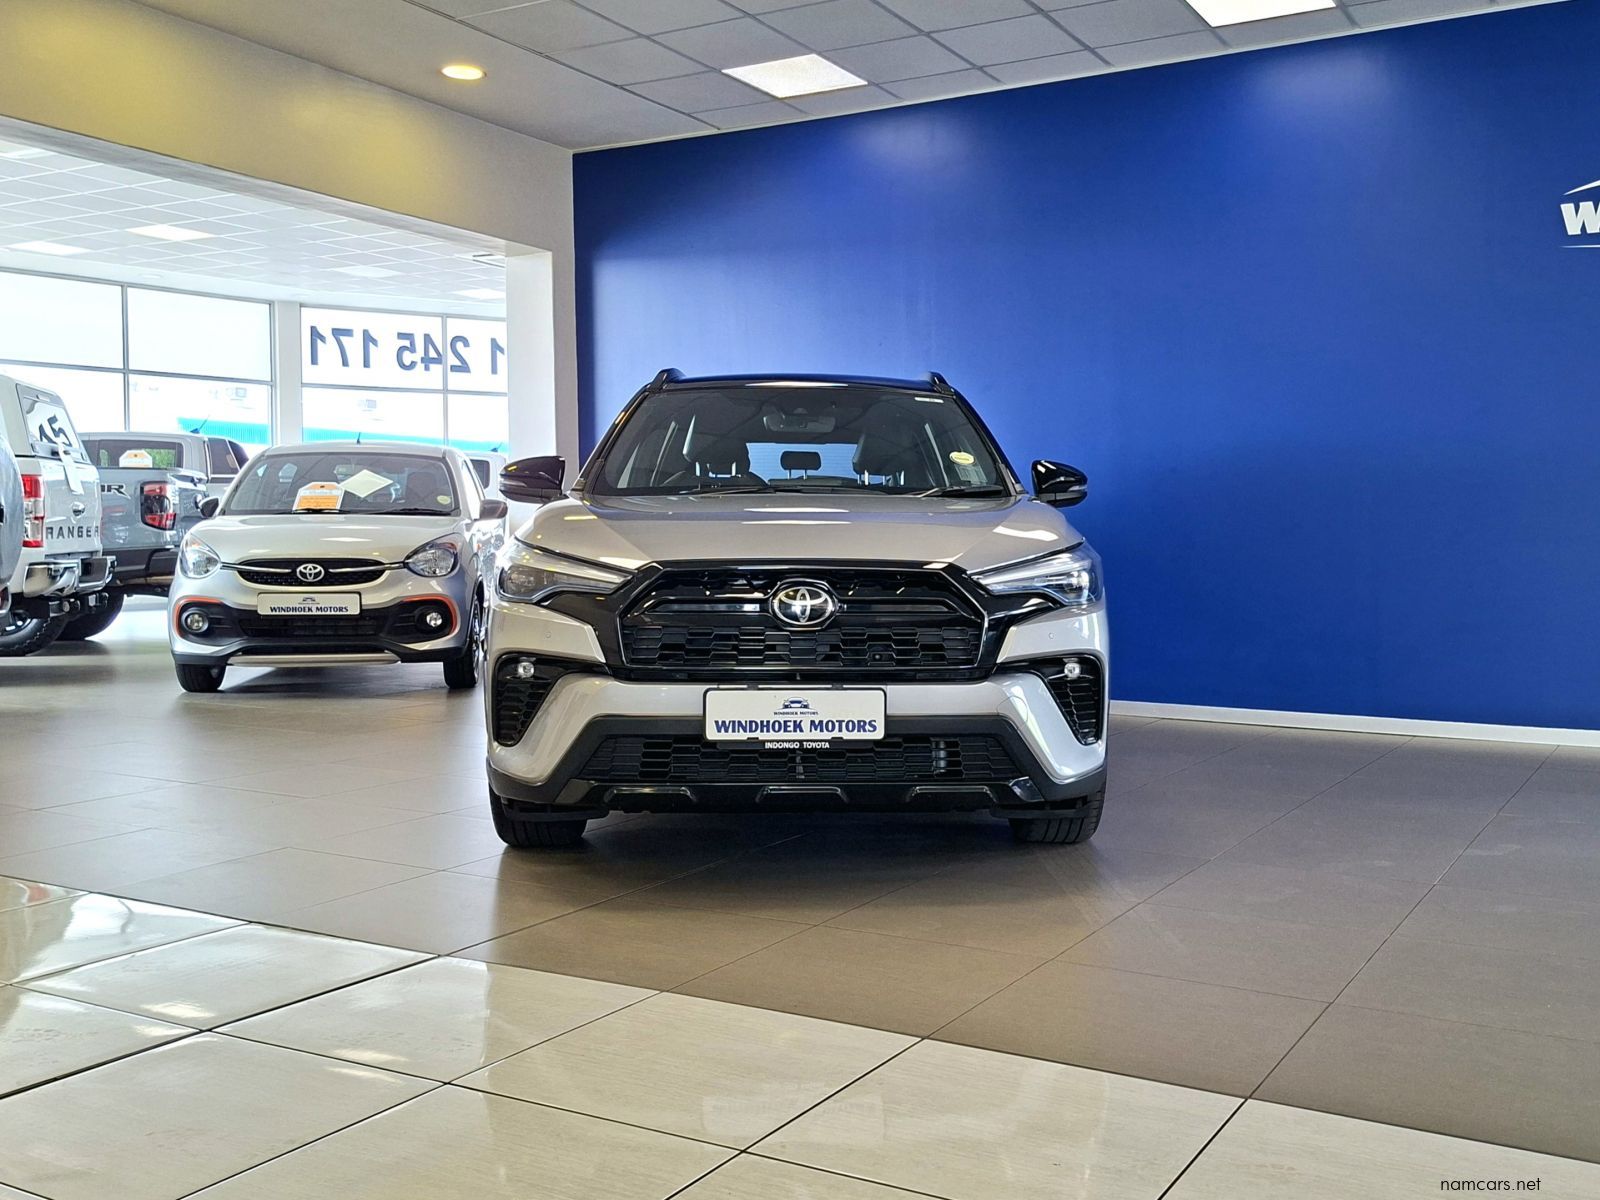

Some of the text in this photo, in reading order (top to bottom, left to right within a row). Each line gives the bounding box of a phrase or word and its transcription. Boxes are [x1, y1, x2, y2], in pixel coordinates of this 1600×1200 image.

[45, 525, 99, 540] RANGER
[714, 719, 878, 733] WINDHOEK MOTORS
